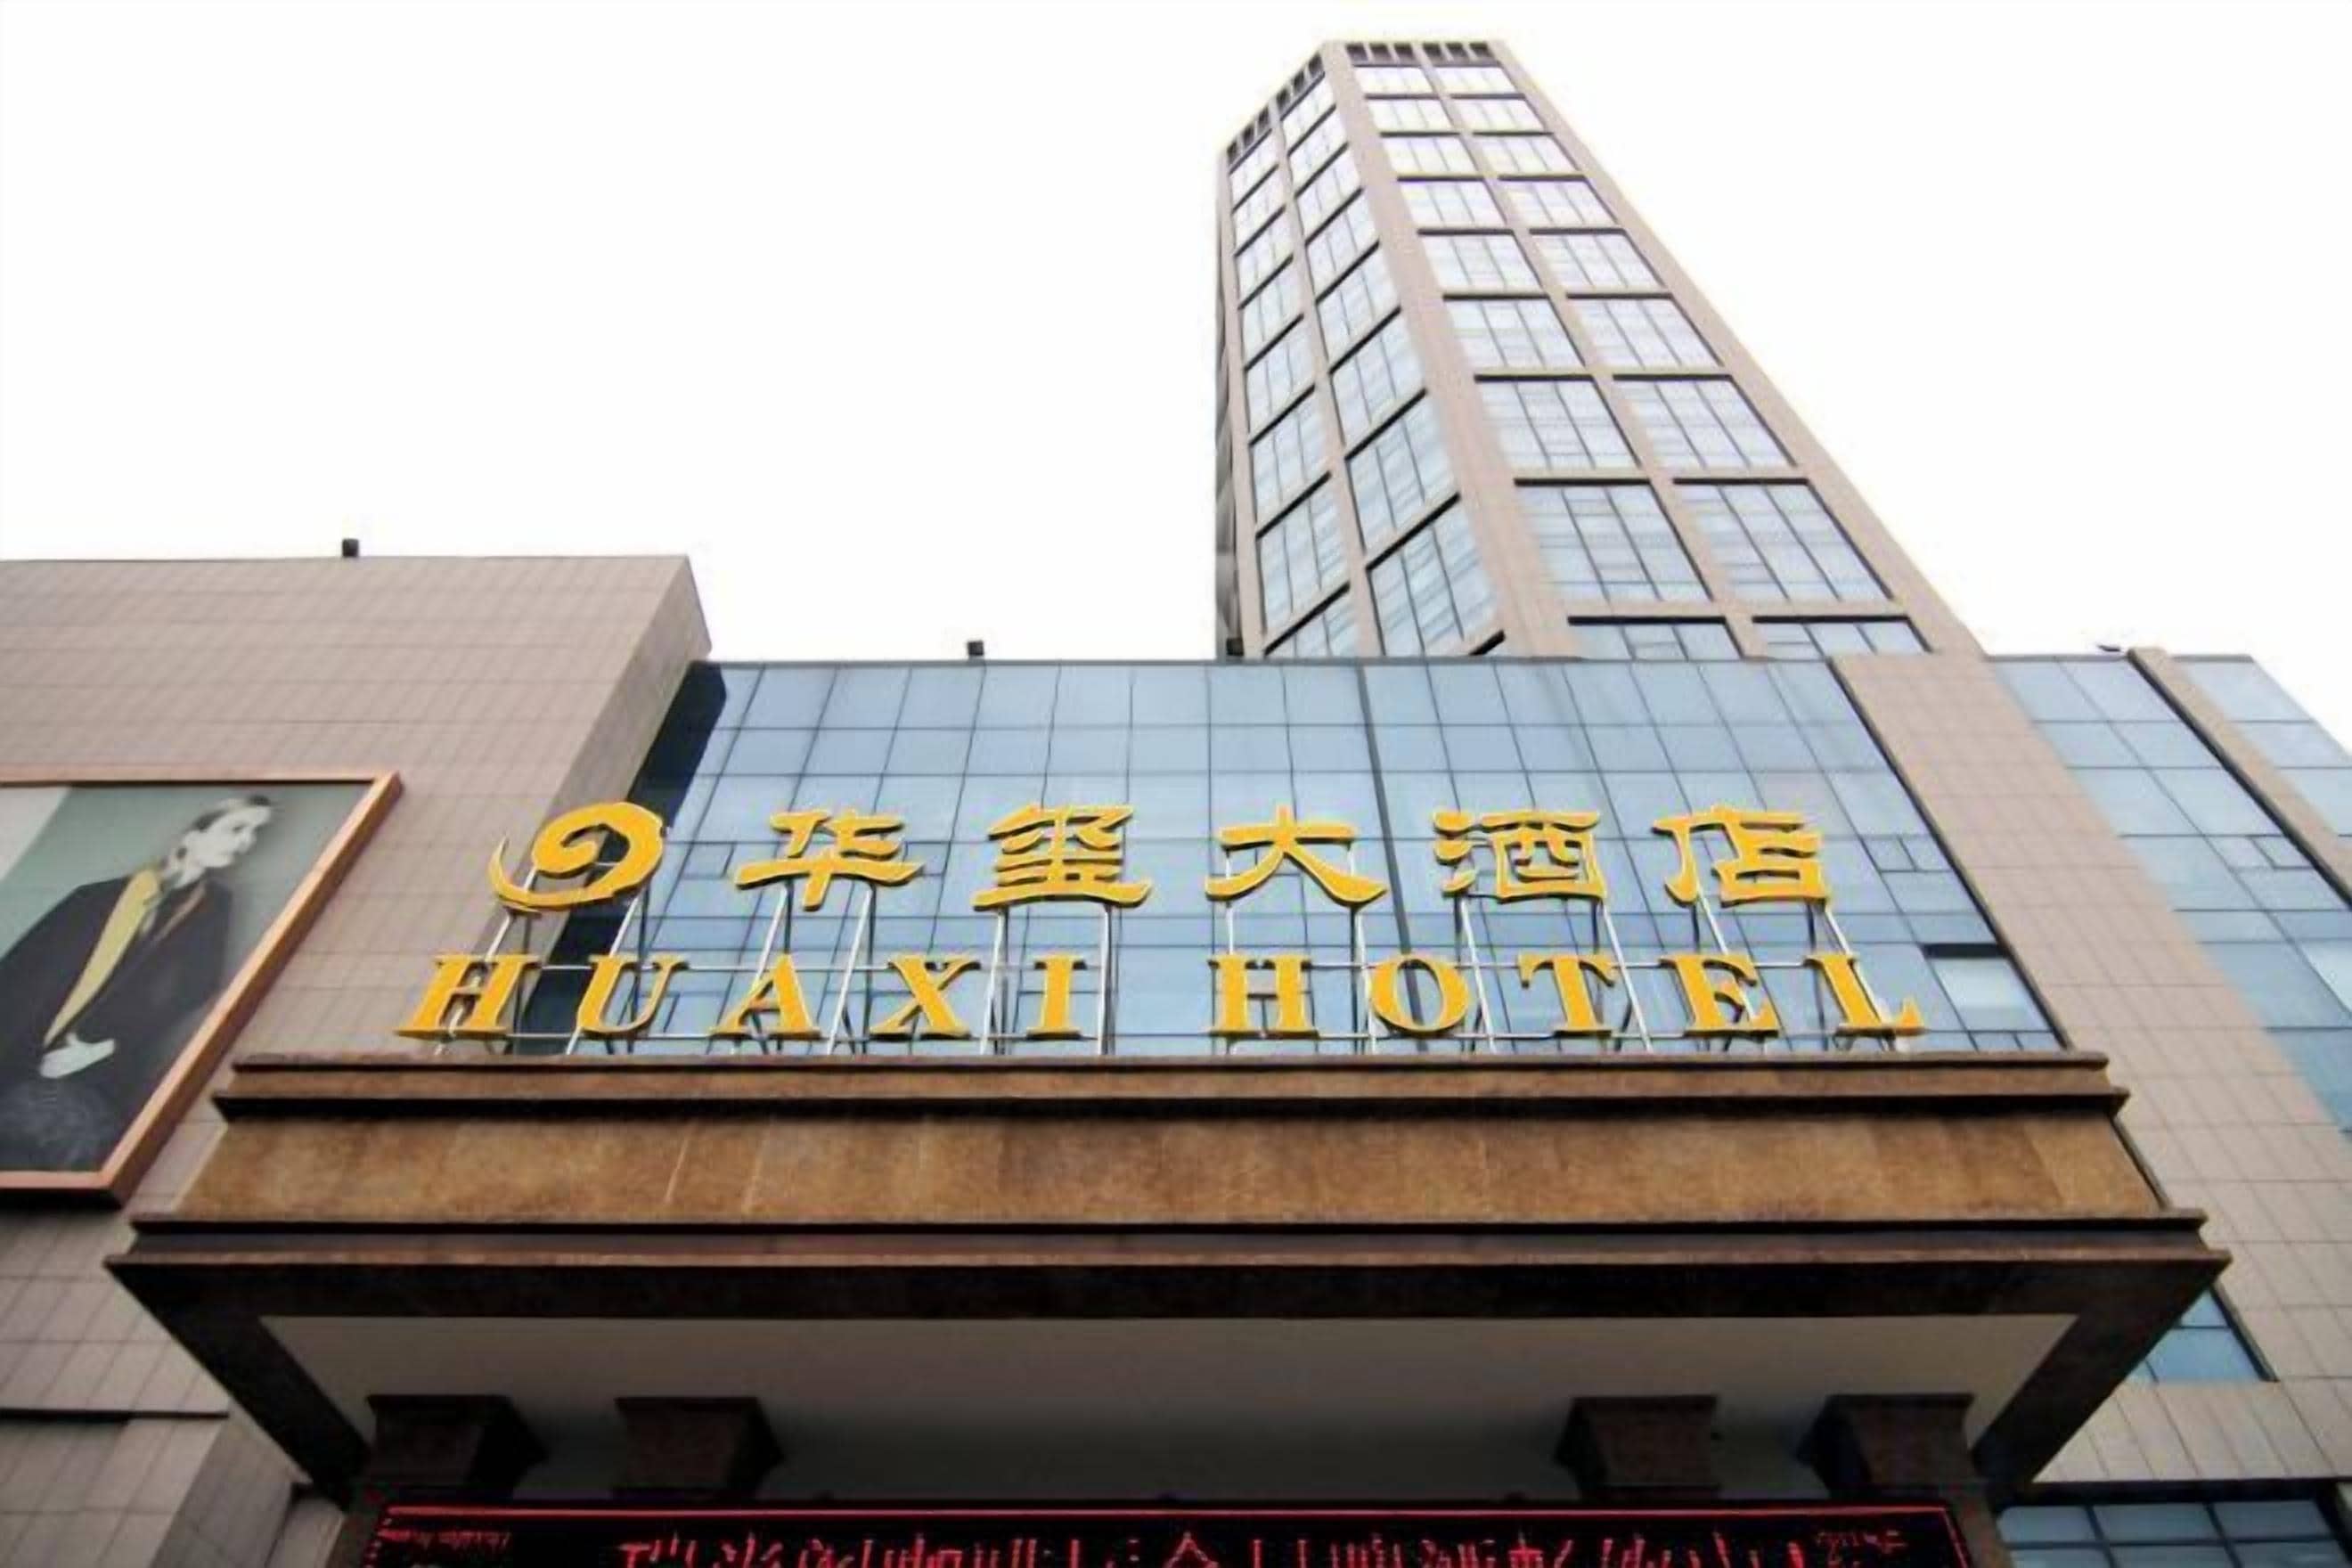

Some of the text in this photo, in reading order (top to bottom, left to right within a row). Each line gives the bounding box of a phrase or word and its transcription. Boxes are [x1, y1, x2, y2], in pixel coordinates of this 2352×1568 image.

[735, 803, 1832, 911] 华玺大酒店
[396, 951, 1924, 1039] HUAXI HOTEL
